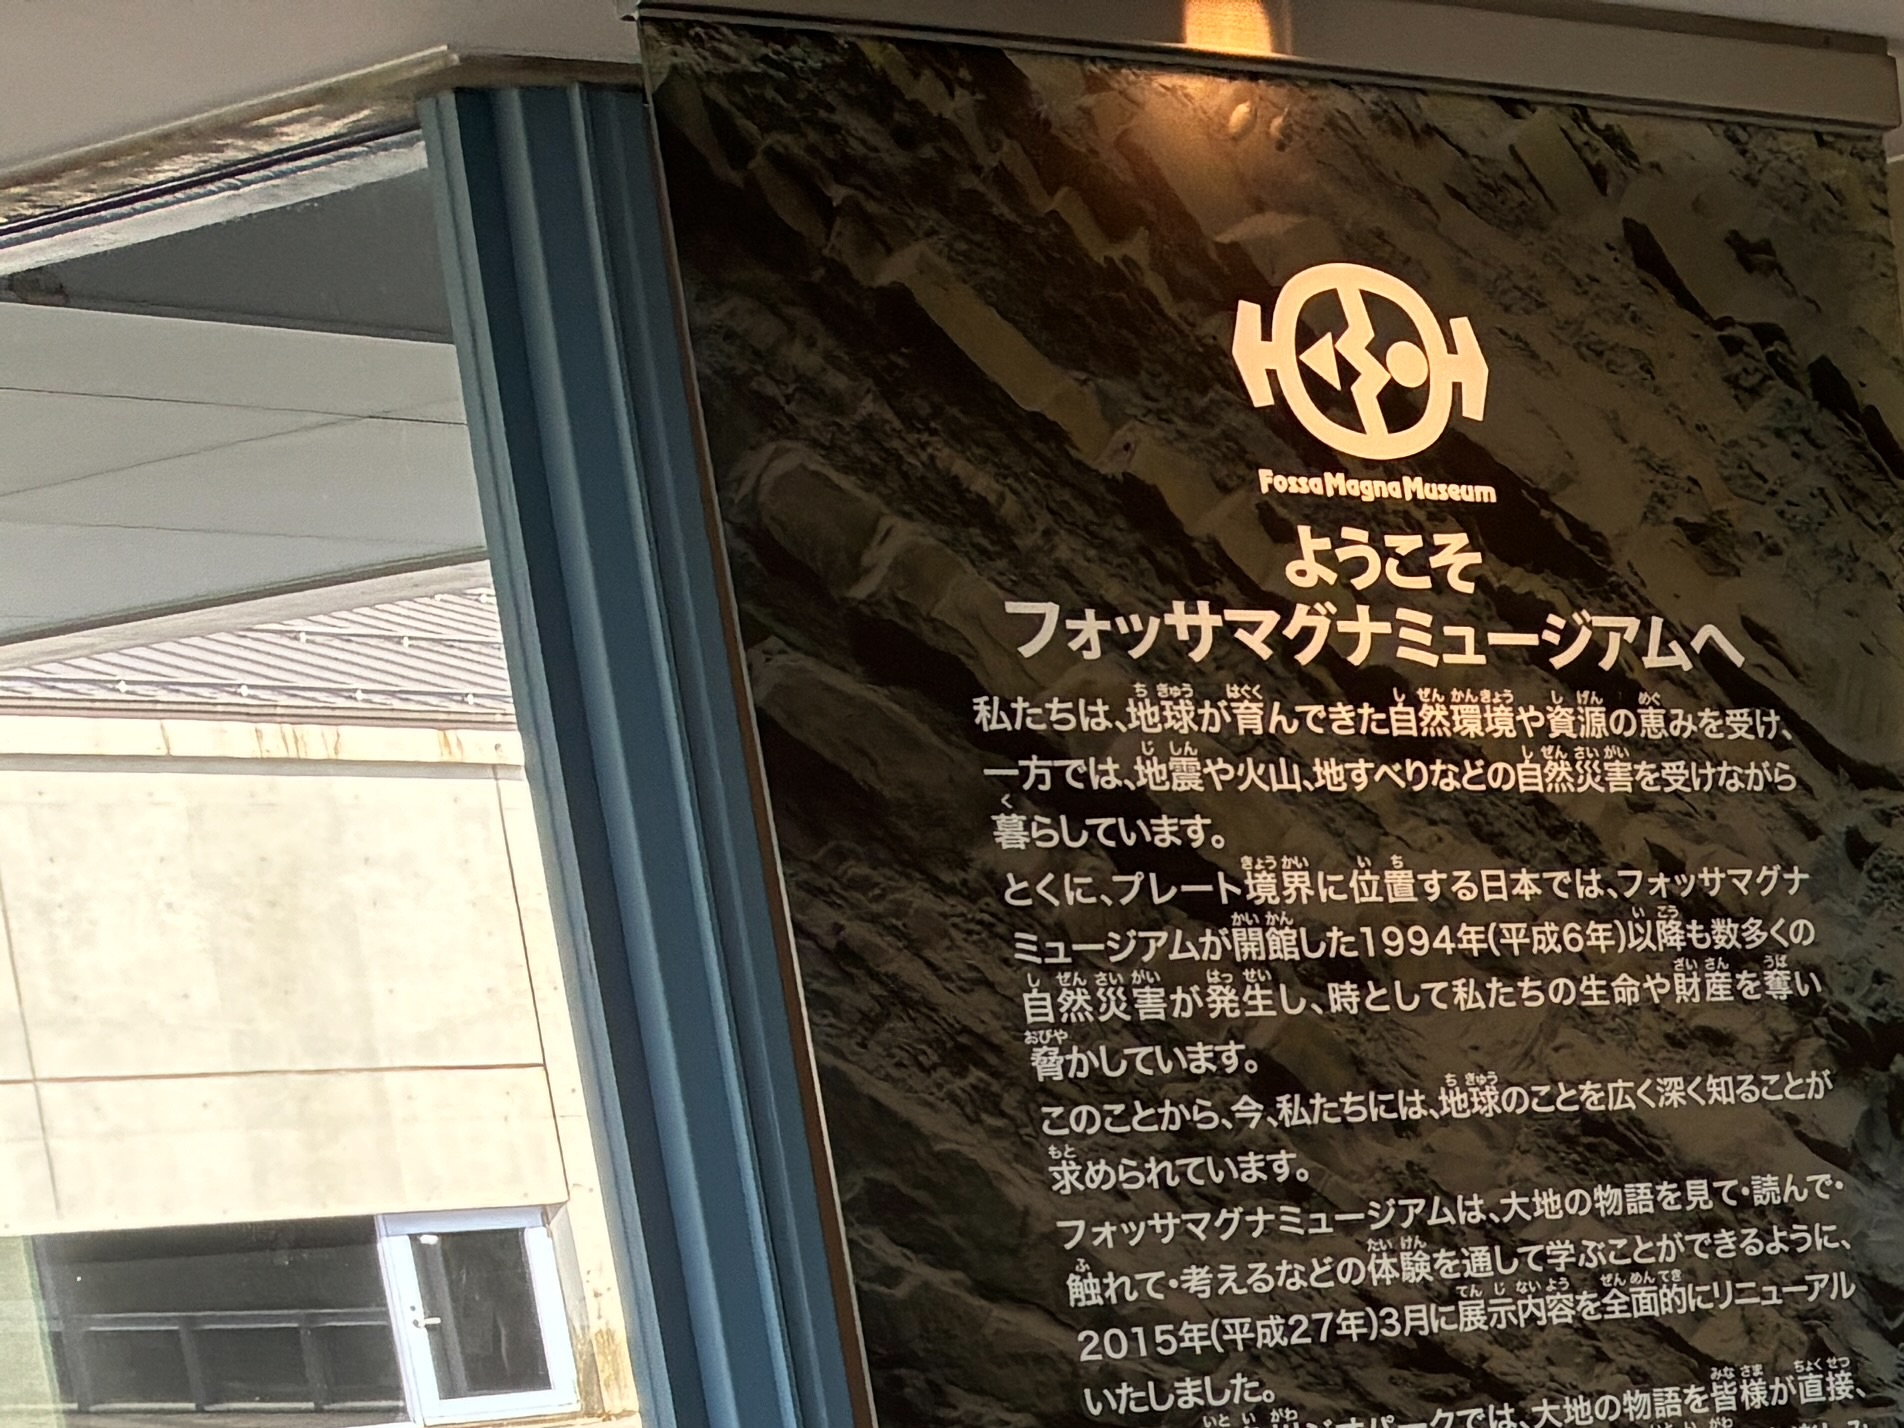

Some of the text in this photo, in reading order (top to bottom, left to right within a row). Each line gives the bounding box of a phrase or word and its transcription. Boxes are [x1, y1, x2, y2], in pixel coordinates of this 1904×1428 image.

[1258, 468, 1497, 504] Fossa Magna Museum
[1285, 525, 1482, 594] ようこそ
[1003, 599, 1745, 670] フォッサマグナミュージアムへ
[990, 812, 1225, 850] 暮らしています。
[1029, 1039, 1258, 1082] 脅かしています。
[1047, 1148, 1309, 1195] 求められています。
[1082, 1371, 1276, 1416] いたしました。
